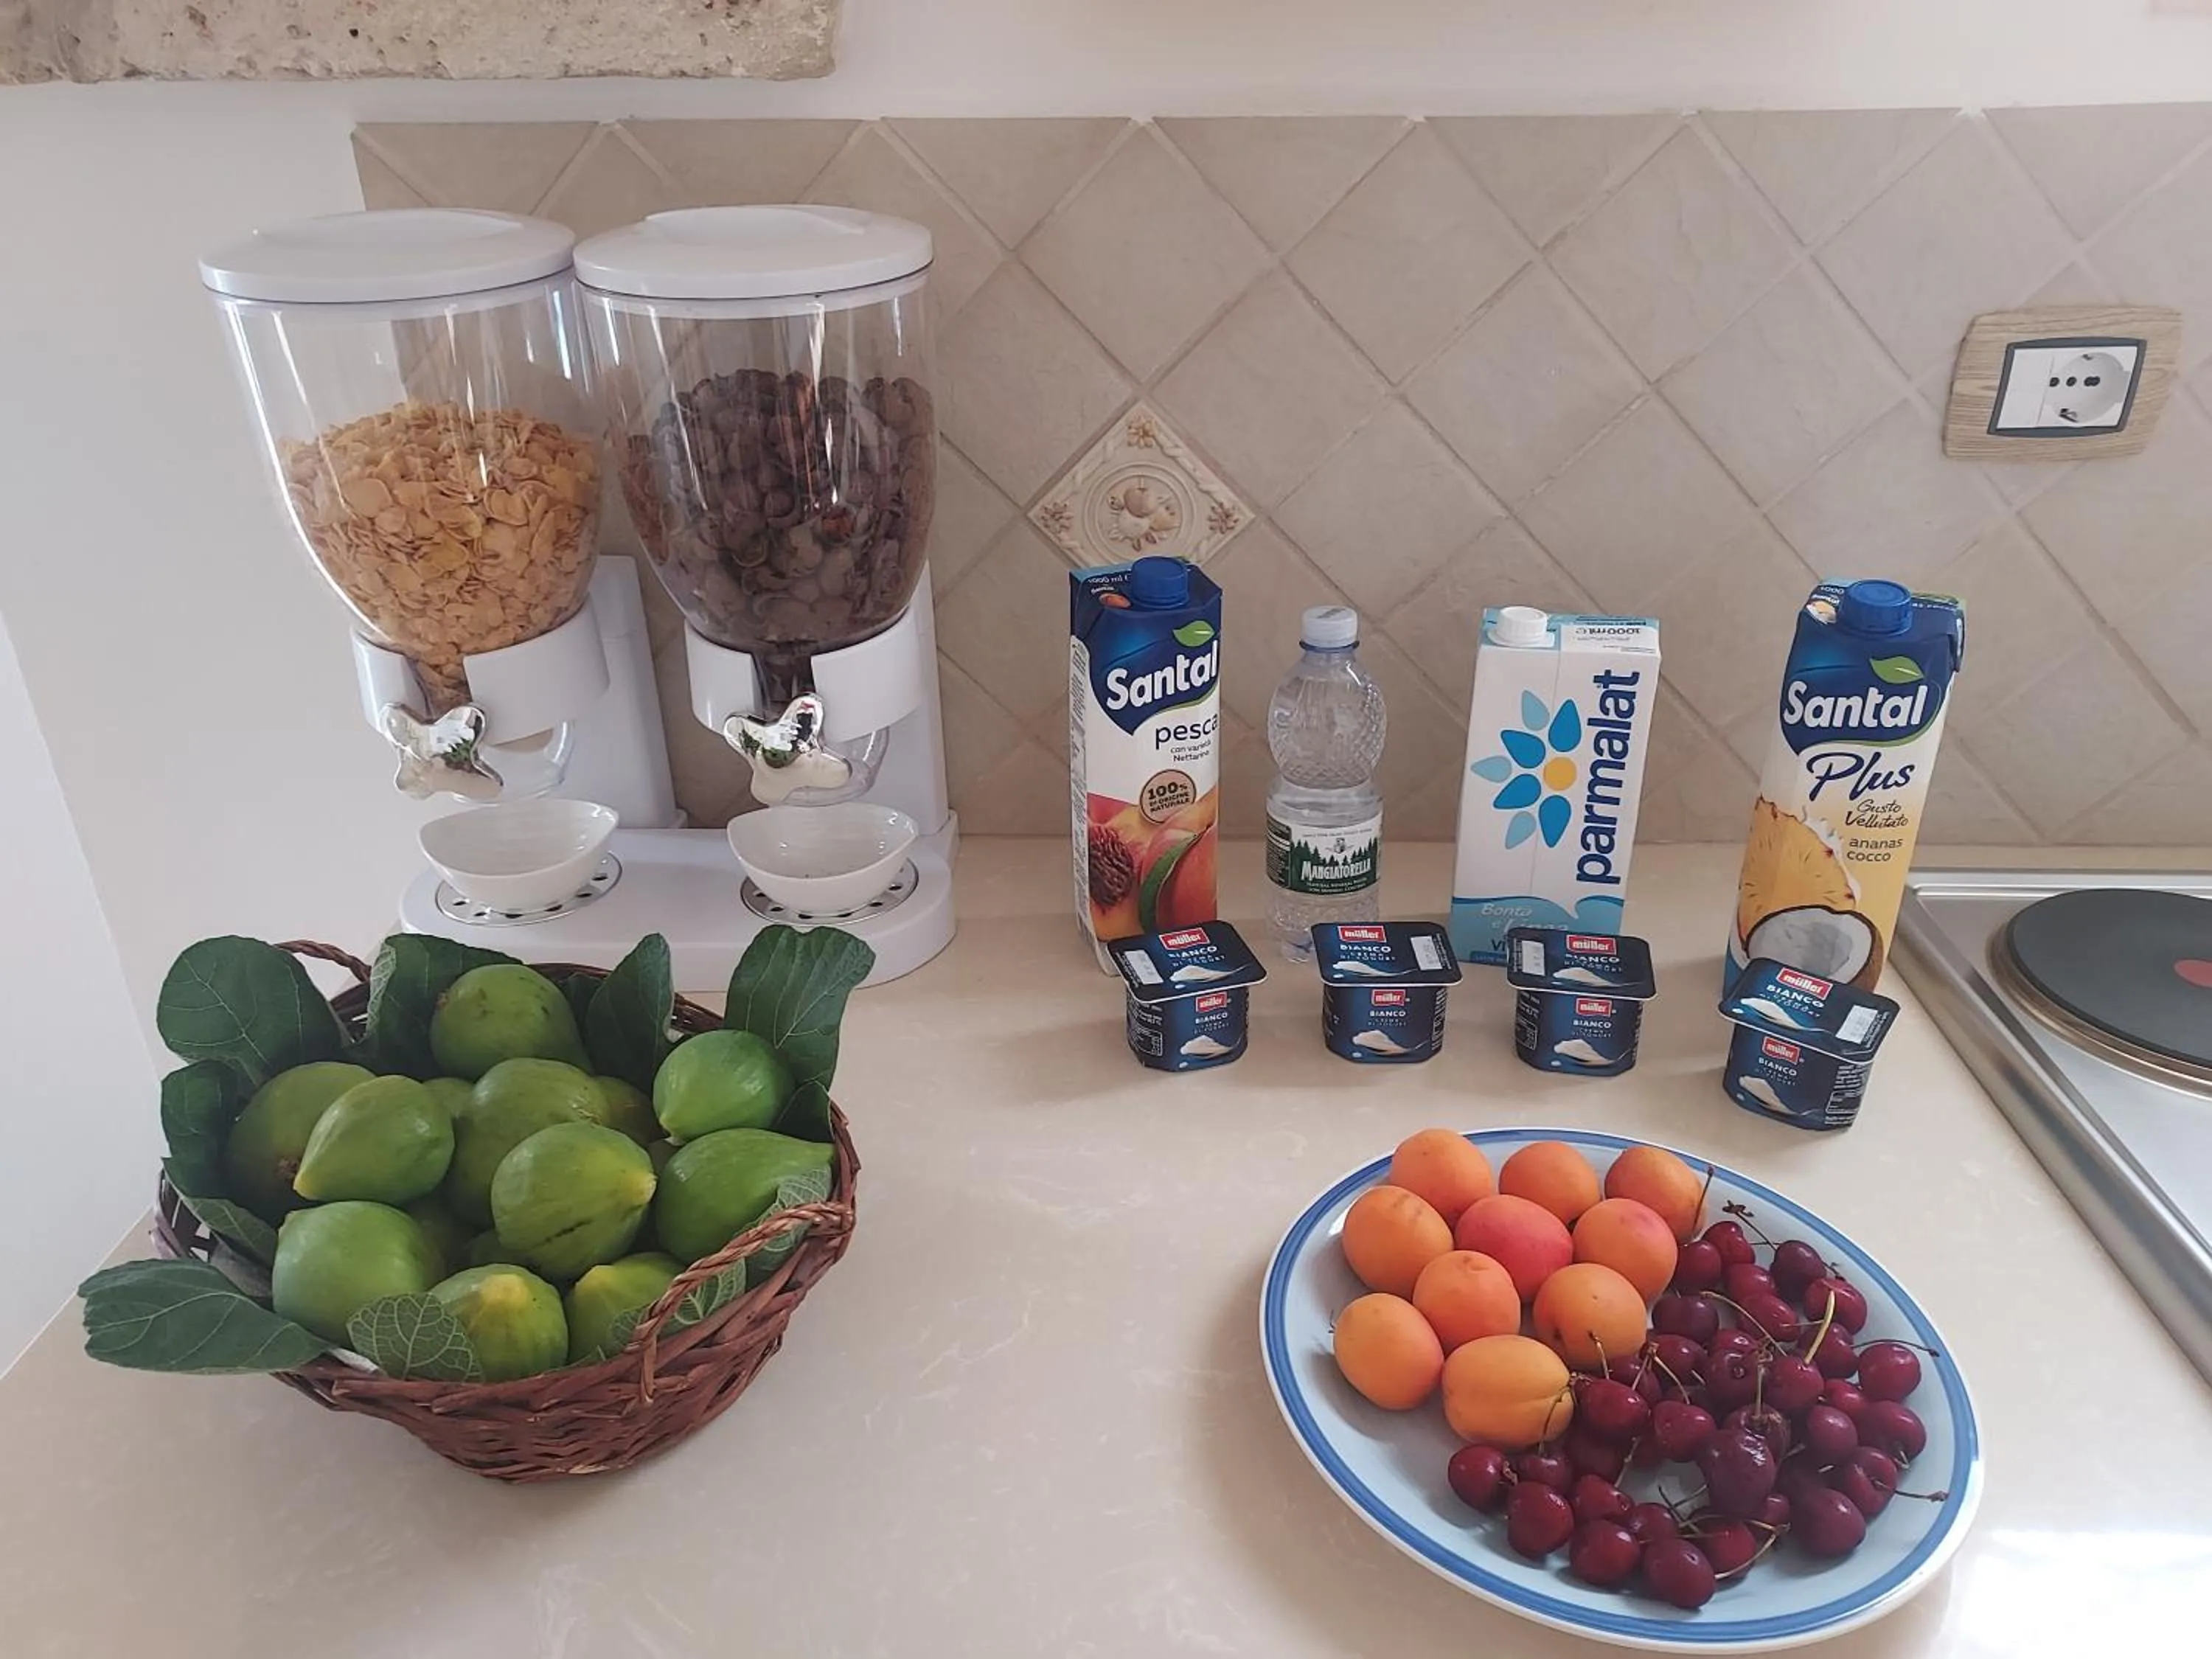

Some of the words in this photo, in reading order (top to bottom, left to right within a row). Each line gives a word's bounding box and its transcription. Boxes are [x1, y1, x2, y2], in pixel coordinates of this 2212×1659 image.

[1107, 640, 1218, 710] Santal
[1783, 681, 1927, 728] Santal
[1155, 713, 1218, 750] pesca
[1576, 669, 1640, 885] parmalat
[1806, 752, 1915, 801] Plus
[1857, 799, 1902, 813] Gusto
[1846, 811, 1908, 829] Vellutato
[1849, 838, 1903, 849] ananas
[1847, 851, 1891, 862] cocco
[1167, 933, 1201, 946] müller
[1344, 929, 1380, 939] müller
[1340, 944, 1392, 953] BIANCO
[1573, 939, 1610, 951] müller
[1783, 974, 1823, 993] müller
[1766, 984, 1825, 1008] BIANCO
[1580, 1002, 1607, 1012] müller
[1195, 1012, 1228, 1024] BIANCO
[1573, 1020, 1612, 1029] BIANCO
[1767, 1042, 1794, 1057] müller
[1759, 1057, 1797, 1077] BIANCO
